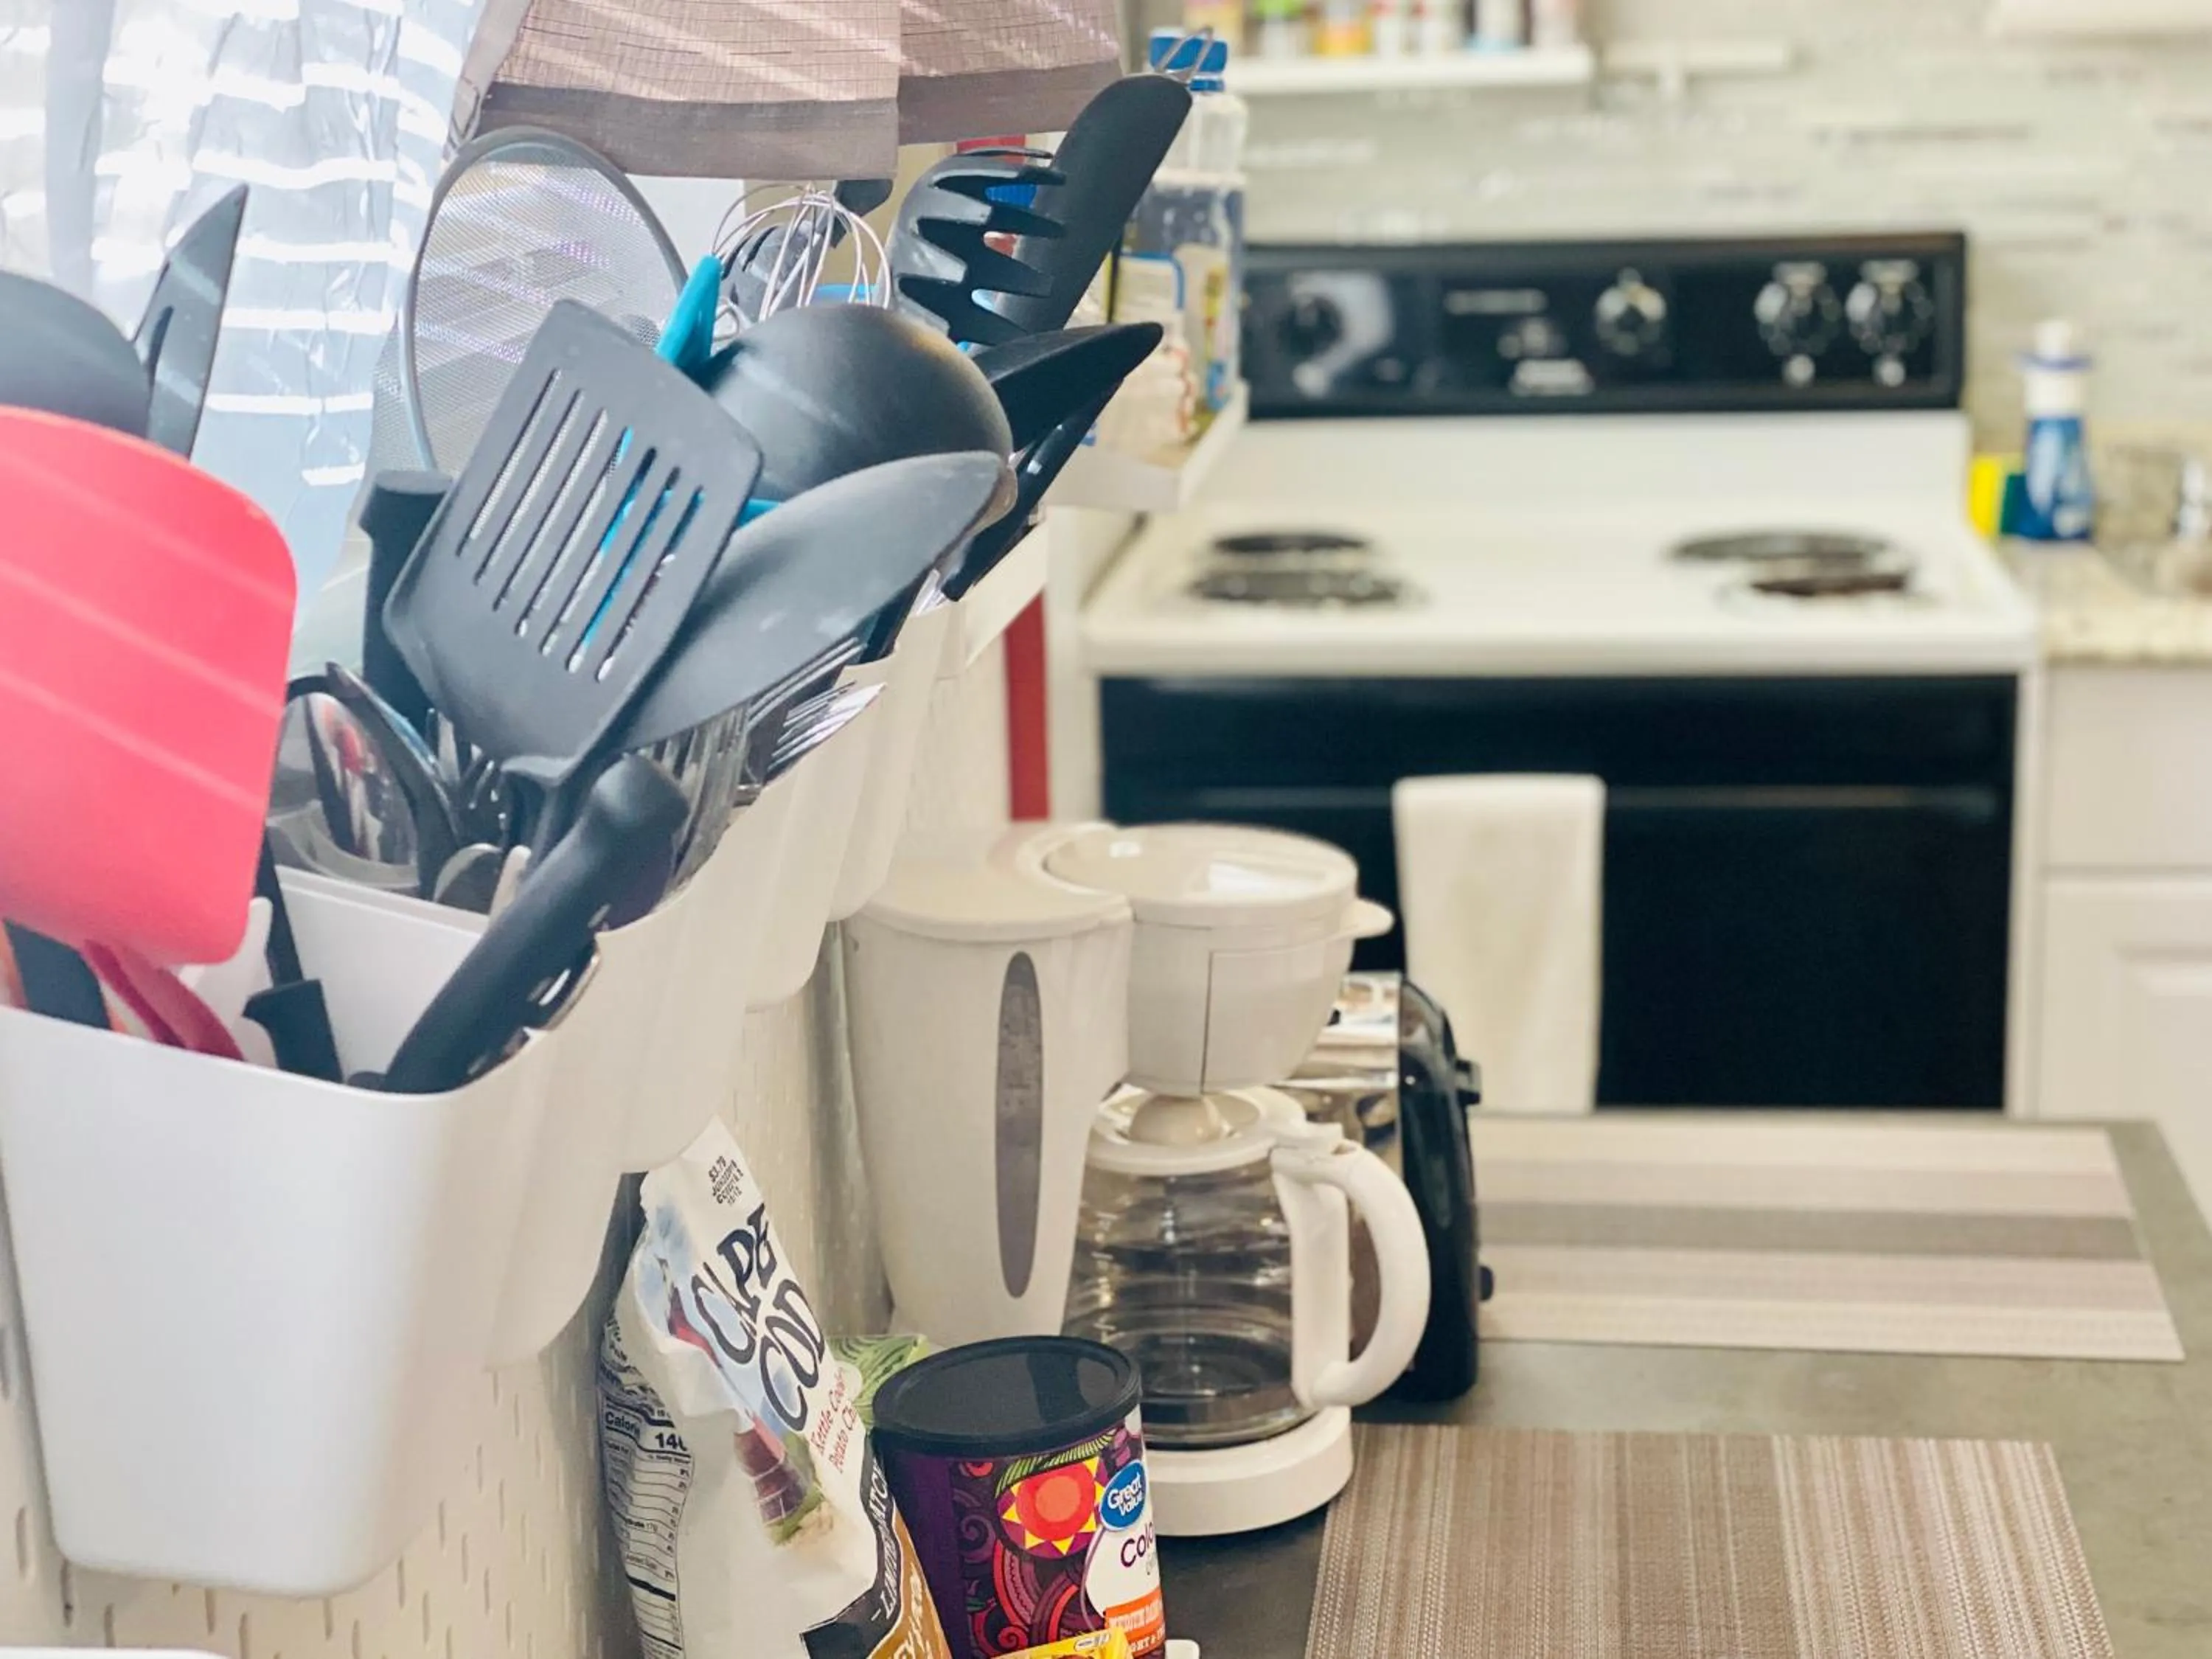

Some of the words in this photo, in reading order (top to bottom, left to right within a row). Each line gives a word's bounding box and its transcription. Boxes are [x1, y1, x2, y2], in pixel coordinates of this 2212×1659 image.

[691, 1203, 777, 1364] CAPE
[759, 1279, 825, 1432] COD
[811, 1410, 833, 1456] Kettle
[1107, 1472, 1142, 1510] Great
[1119, 1489, 1144, 1517] Value
